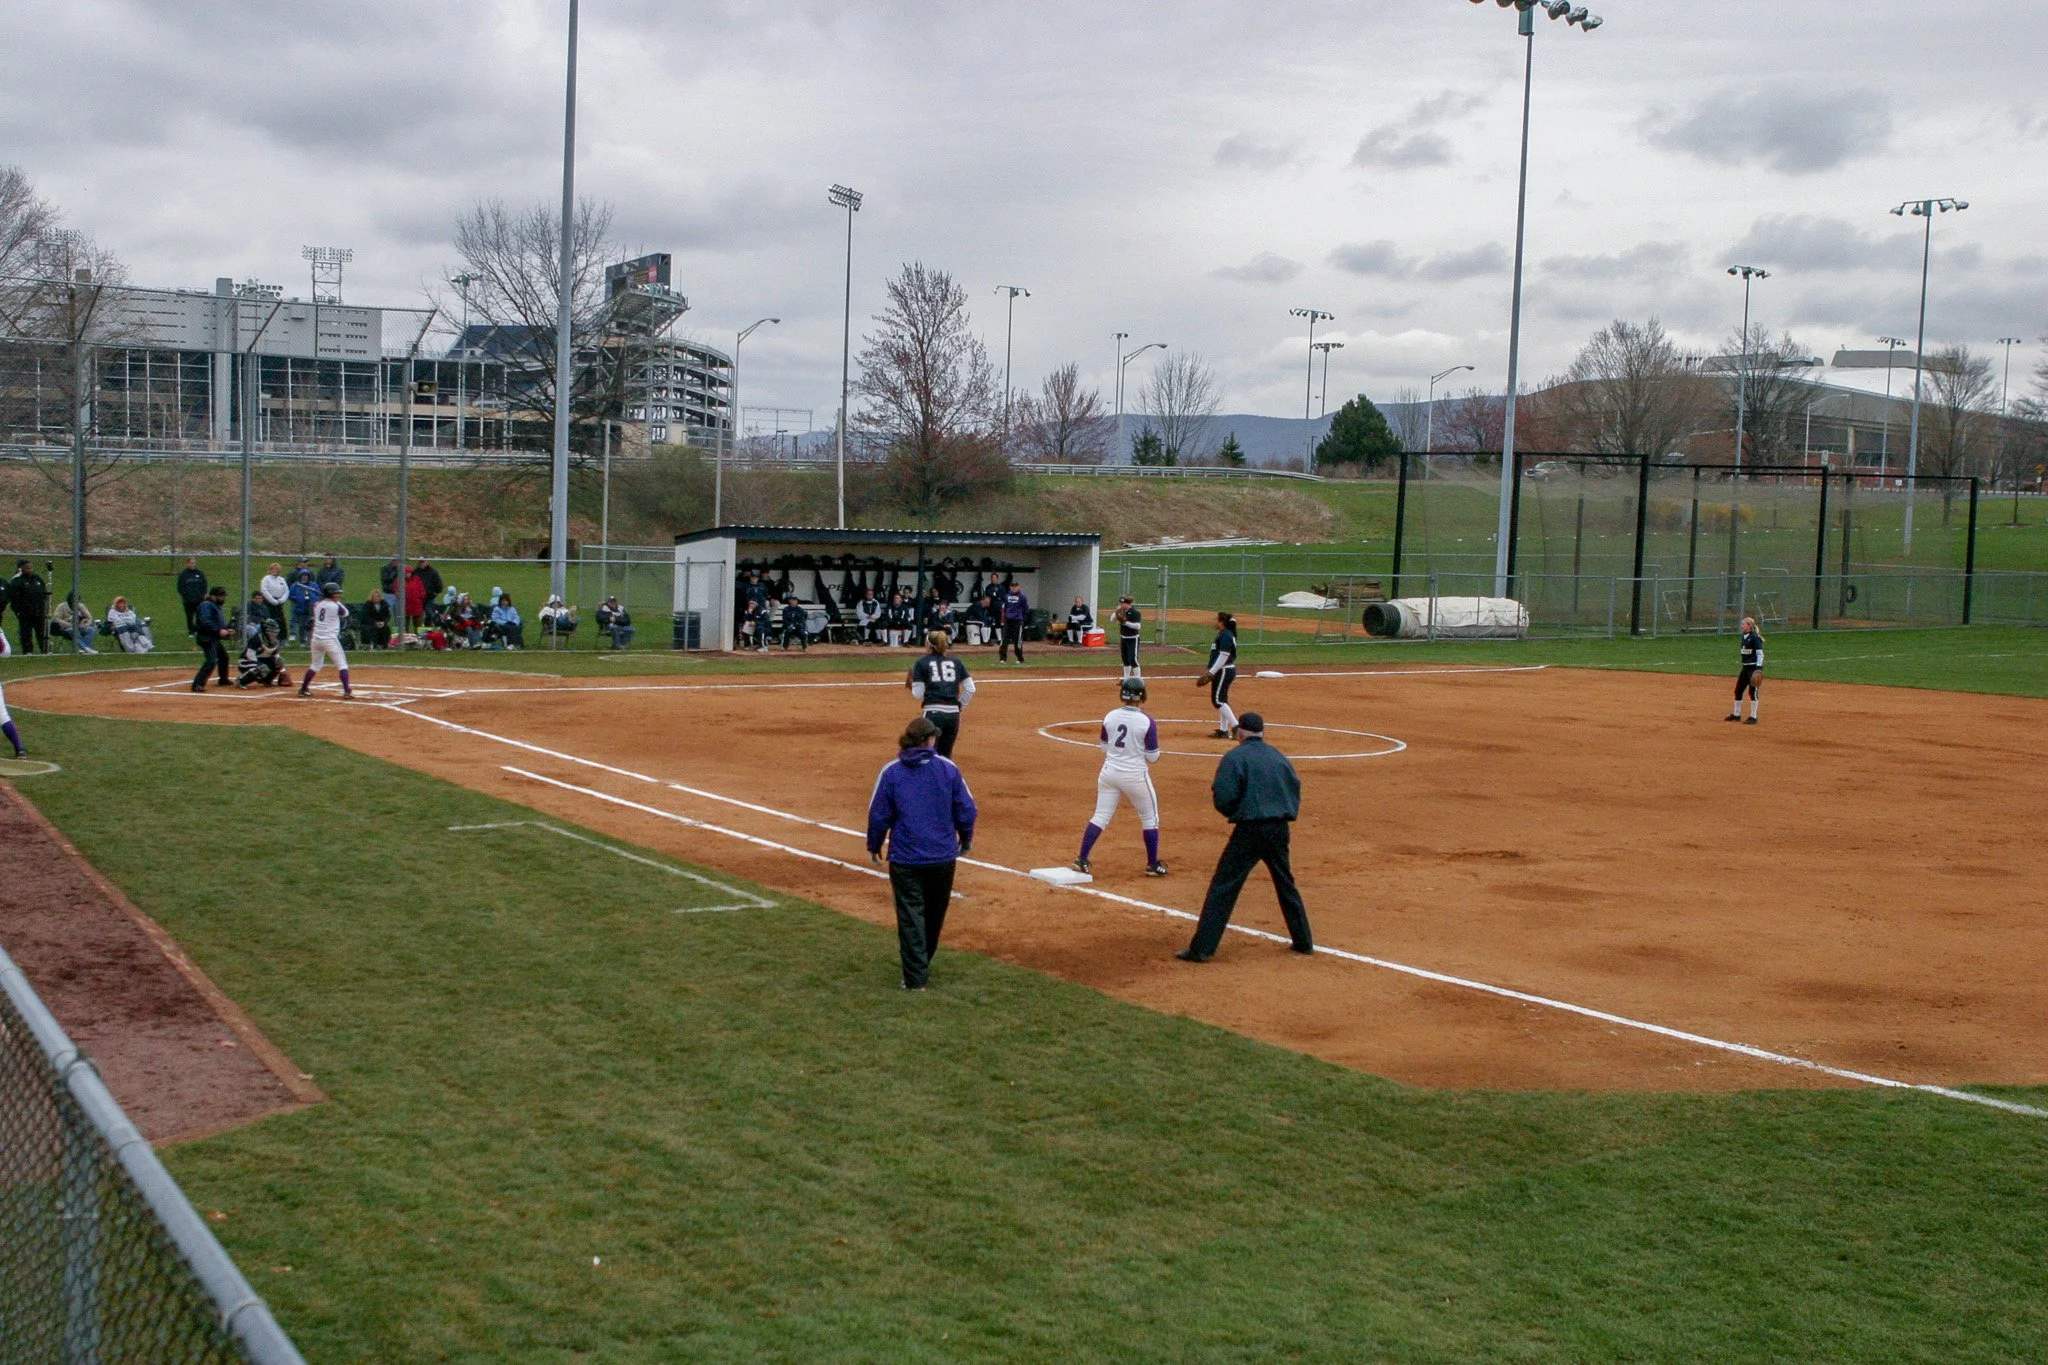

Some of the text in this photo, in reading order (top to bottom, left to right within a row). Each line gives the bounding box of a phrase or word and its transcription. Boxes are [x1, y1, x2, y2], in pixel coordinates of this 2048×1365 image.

[319, 607, 326, 622] 8
[928, 660, 957, 682] 16
[1114, 723, 1128, 748] 2
